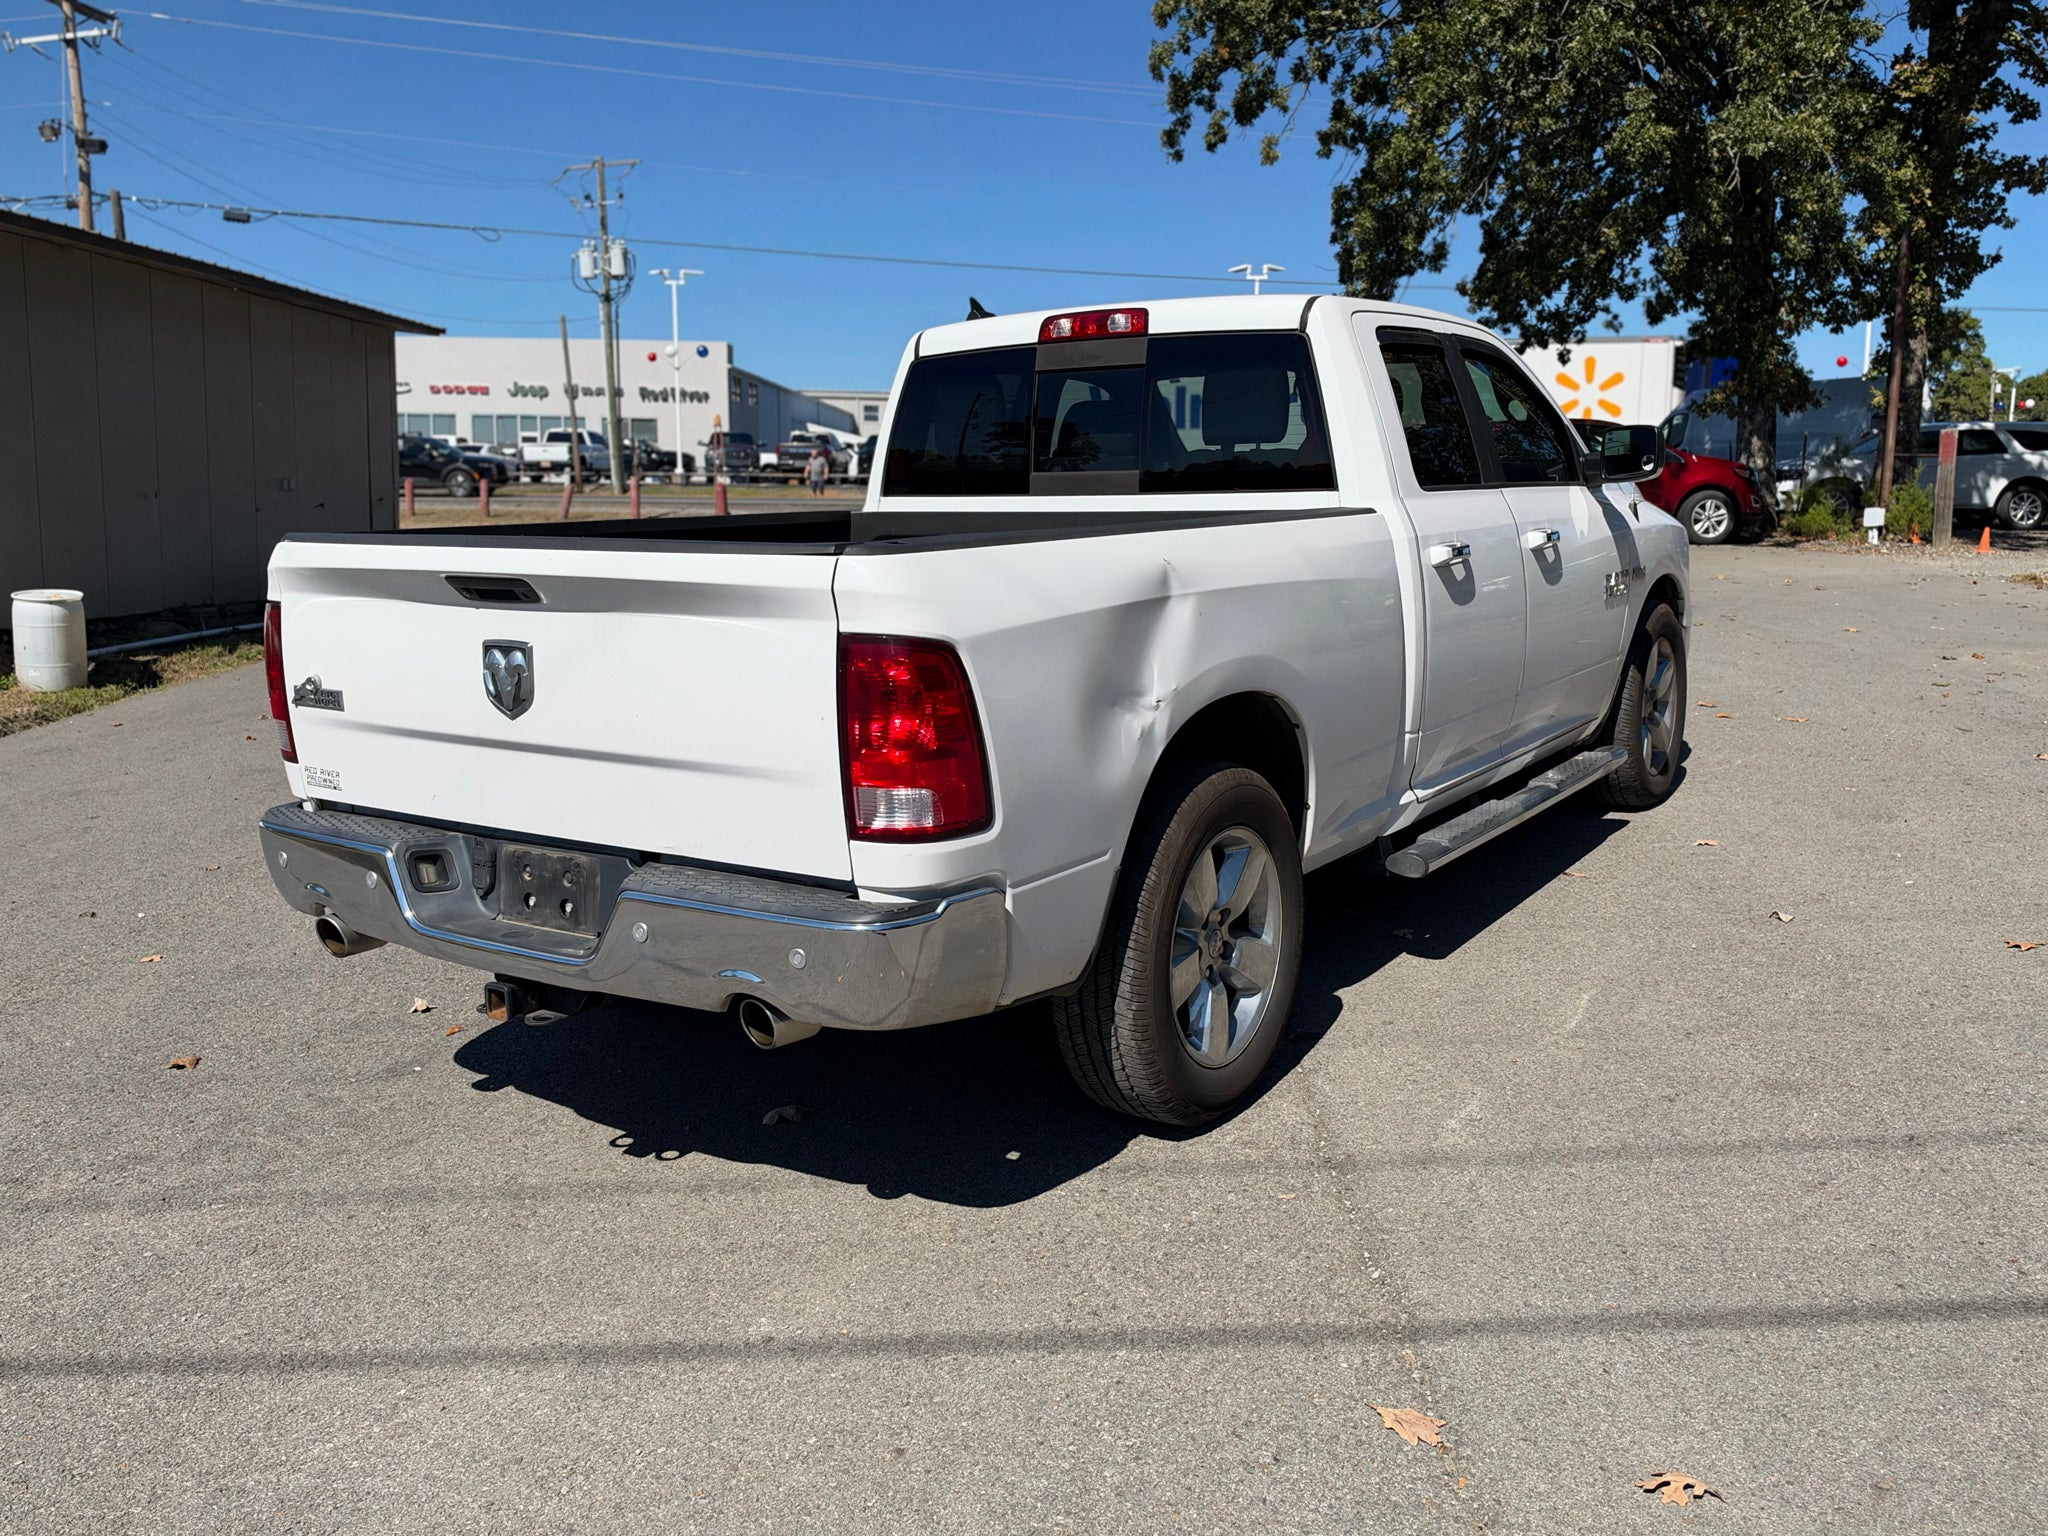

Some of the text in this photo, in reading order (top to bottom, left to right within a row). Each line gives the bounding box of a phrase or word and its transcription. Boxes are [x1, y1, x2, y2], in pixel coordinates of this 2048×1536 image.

[507, 381, 550, 400] Jeep
[320, 690, 338, 699] BIG
[315, 698, 341, 708] HORN
[304, 765, 340, 779] RED RIVER
[306, 774, 341, 787] PREOWNED
